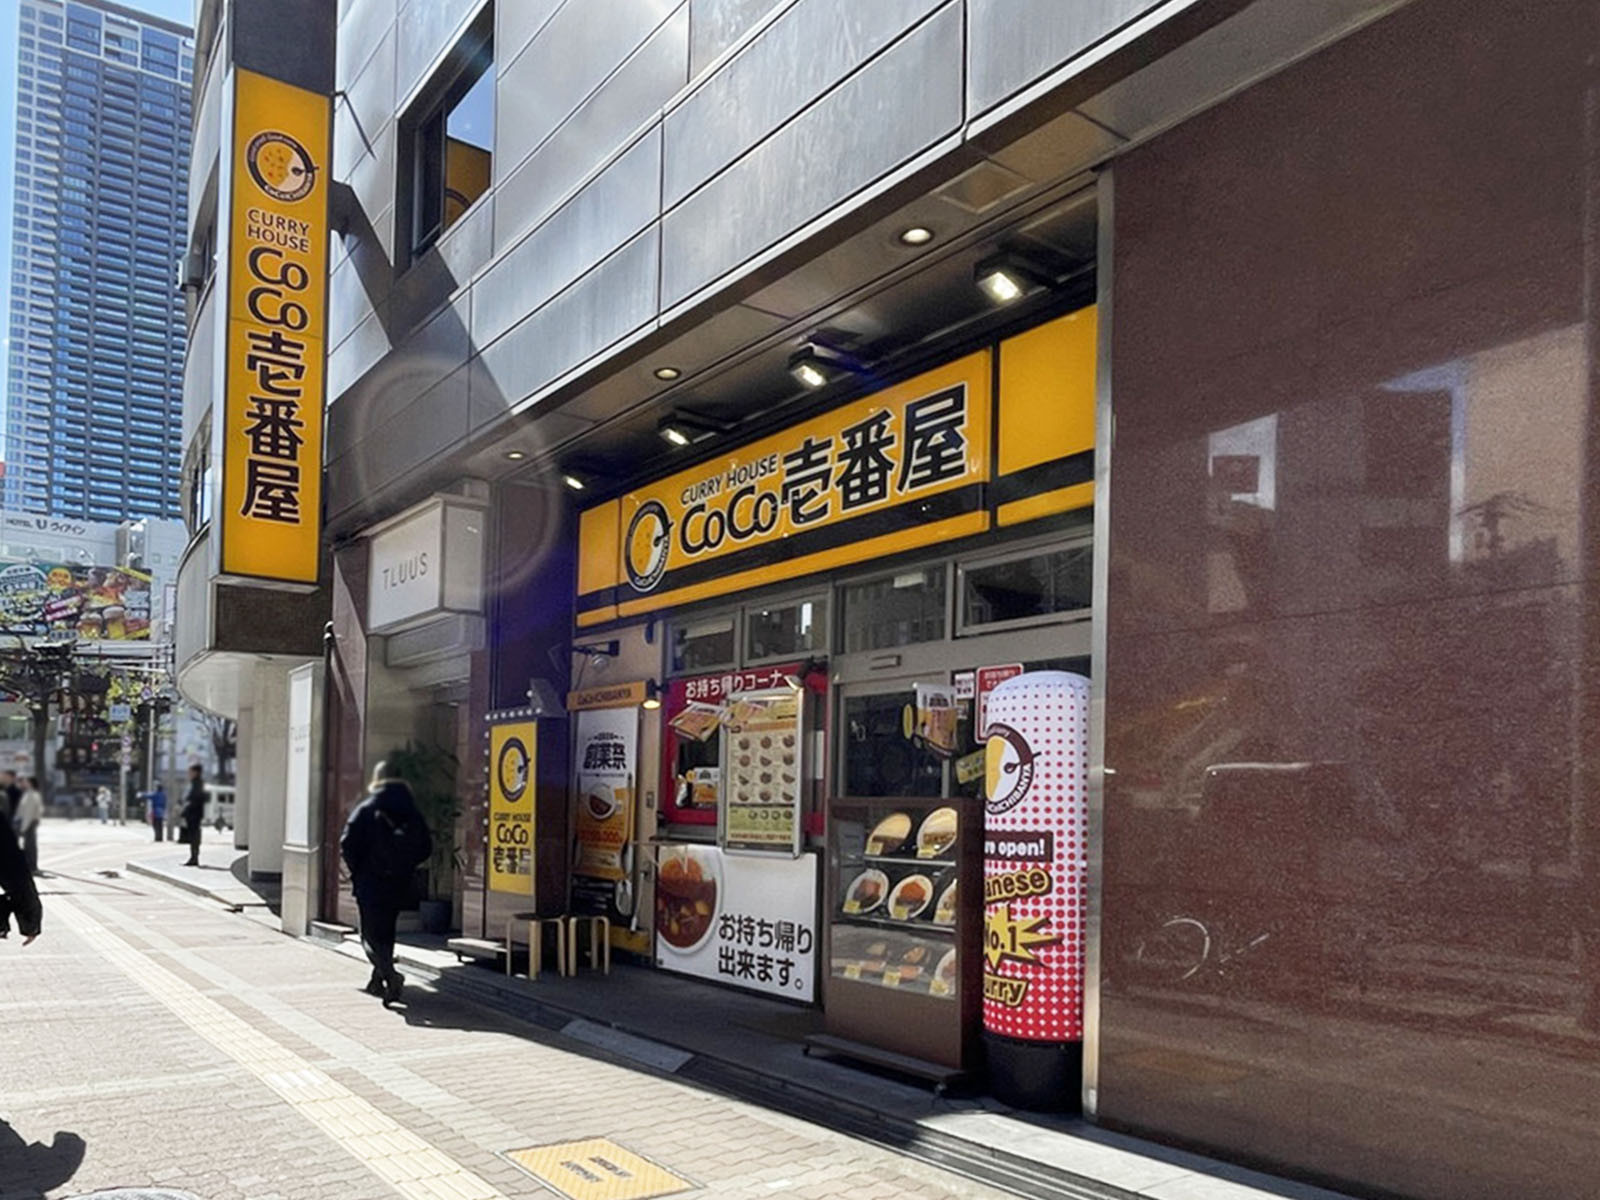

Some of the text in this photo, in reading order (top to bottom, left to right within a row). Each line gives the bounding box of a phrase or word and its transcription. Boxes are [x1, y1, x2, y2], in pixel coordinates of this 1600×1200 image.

[248, 209, 310, 236] CURRY
[248, 224, 310, 253] HOUSE
[681, 453, 778, 505] CURRY HOUSE
[382, 552, 429, 590] TLUUS
[496, 823, 529, 845] CoCo
[998, 838, 1046, 858] open!
[718, 913, 813, 955] お持ち帰り
[718, 945, 804, 990] 出来ます。
